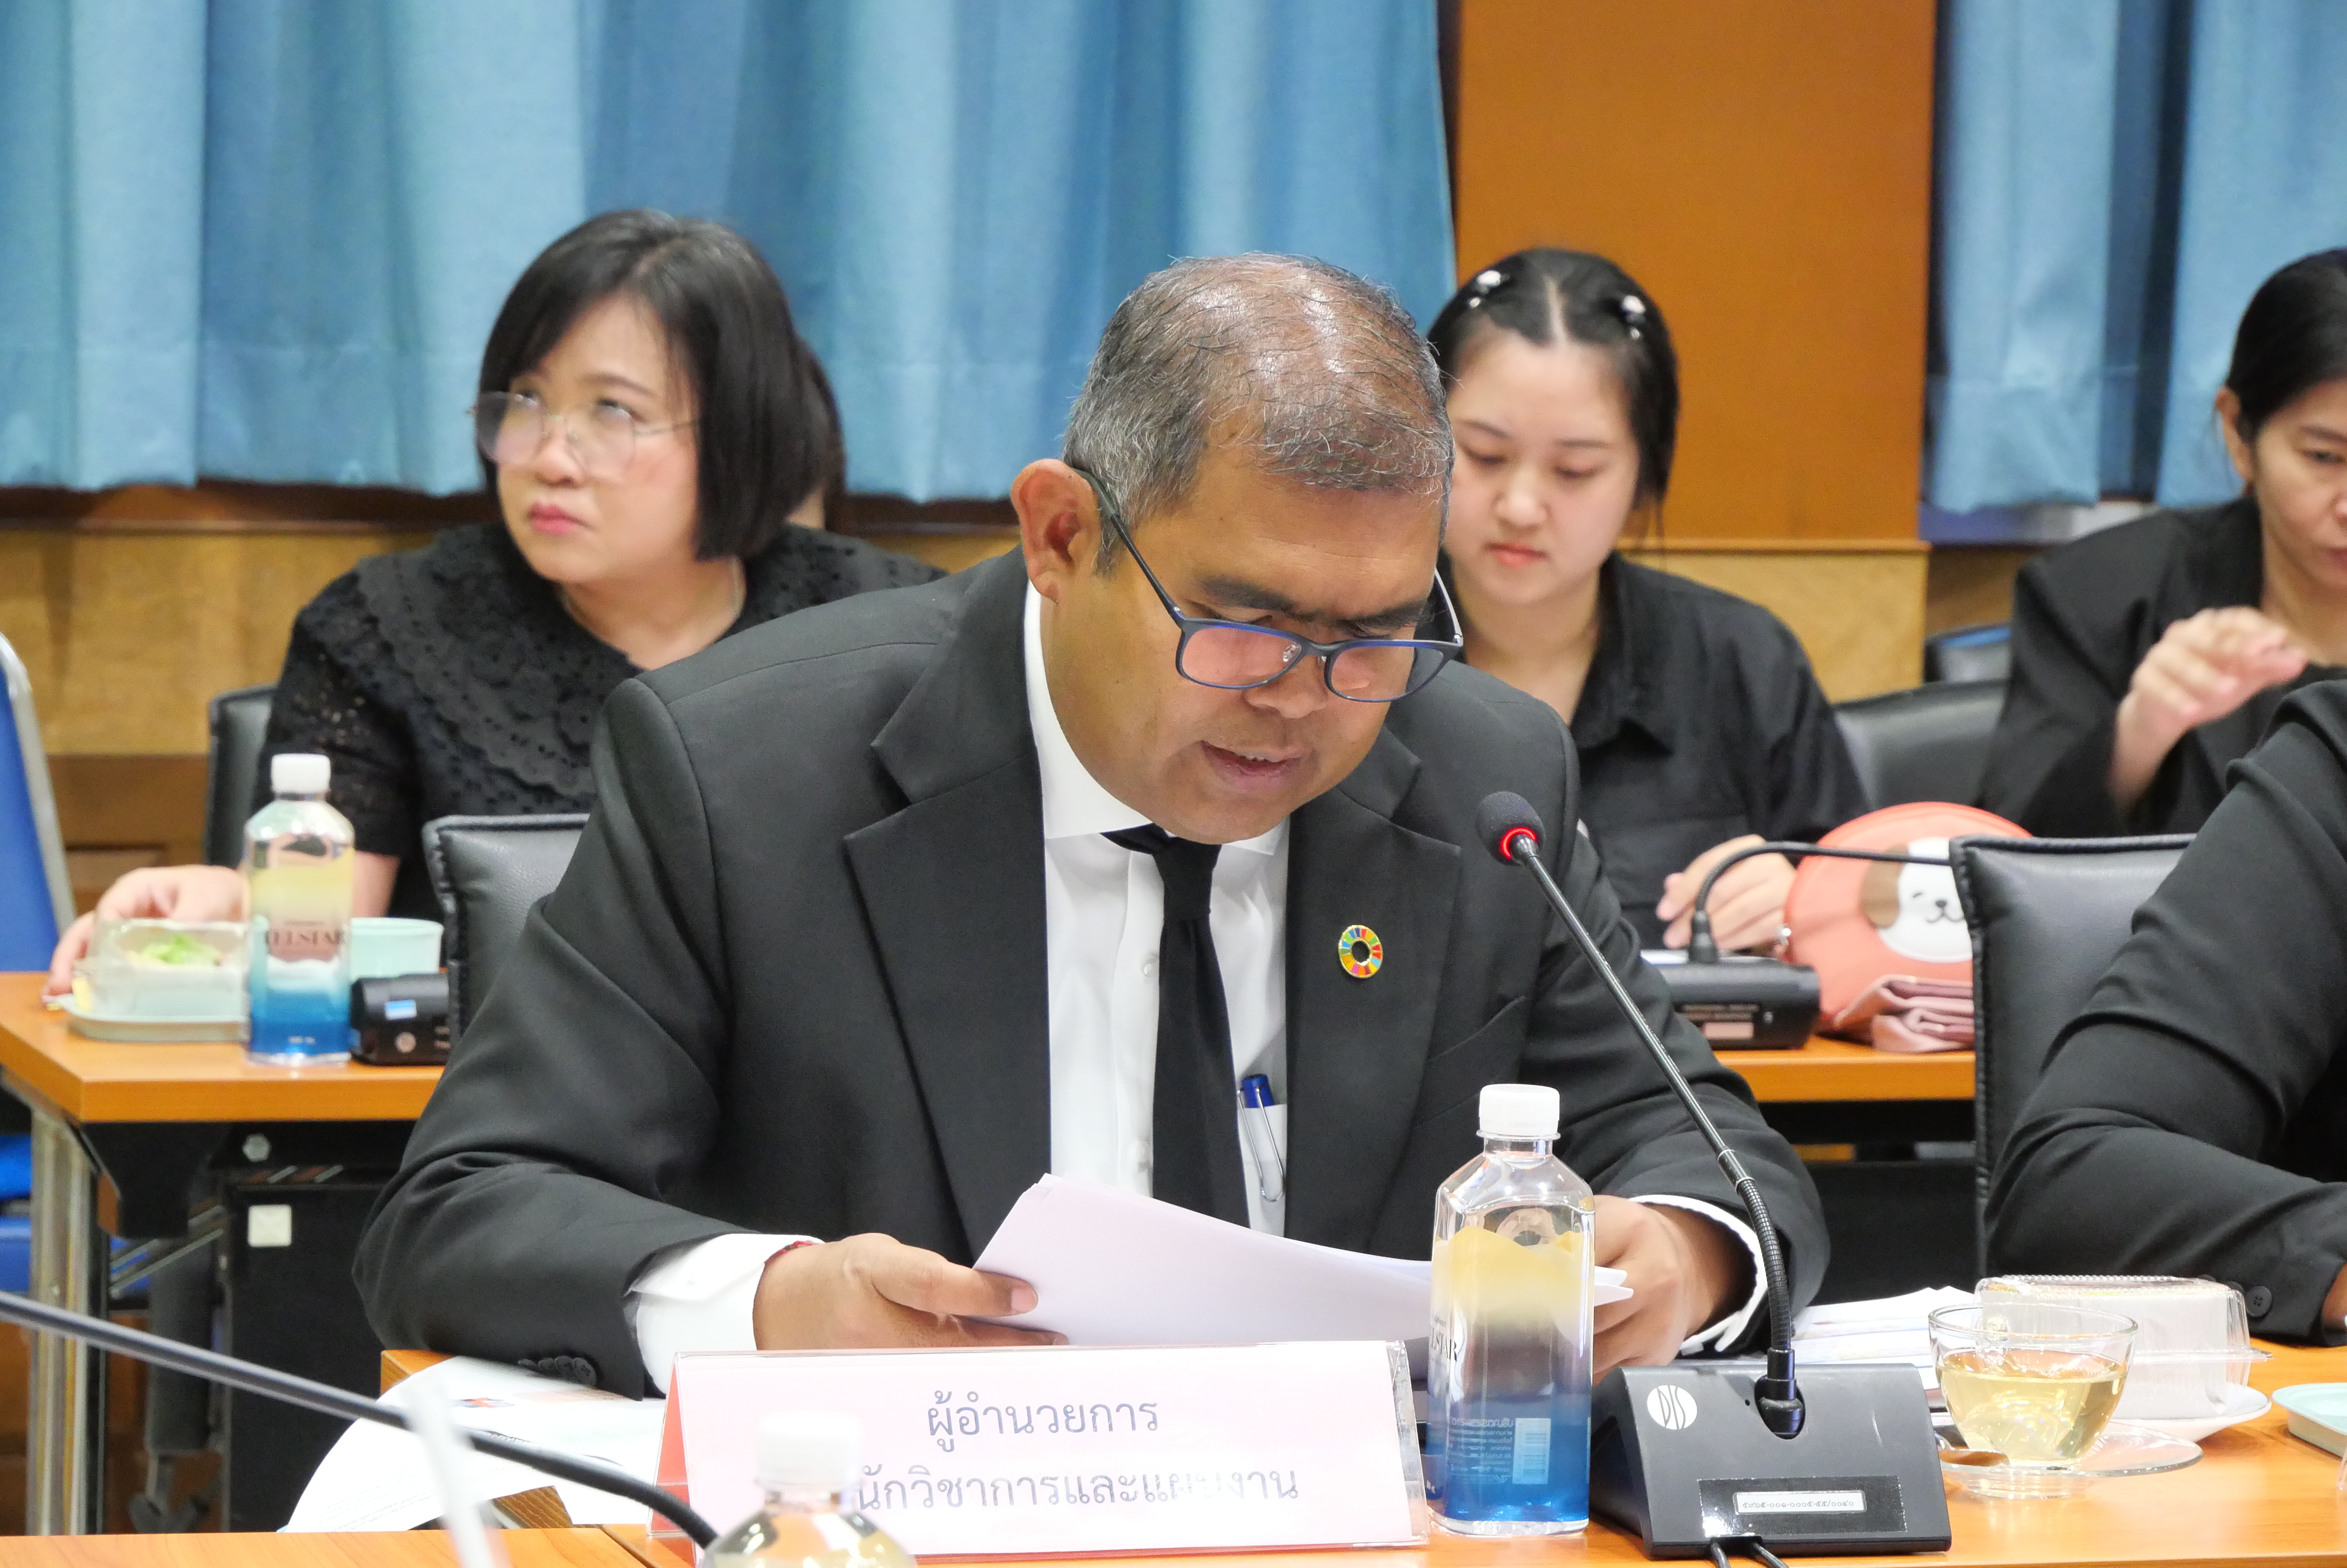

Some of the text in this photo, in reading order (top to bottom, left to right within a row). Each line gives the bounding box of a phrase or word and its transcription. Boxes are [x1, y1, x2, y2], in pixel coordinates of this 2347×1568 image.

[927, 1390, 1159, 1453] ผู้อำนวยการ
[858, 1463, 1299, 1510] นักวิชาการและแผนงาน
